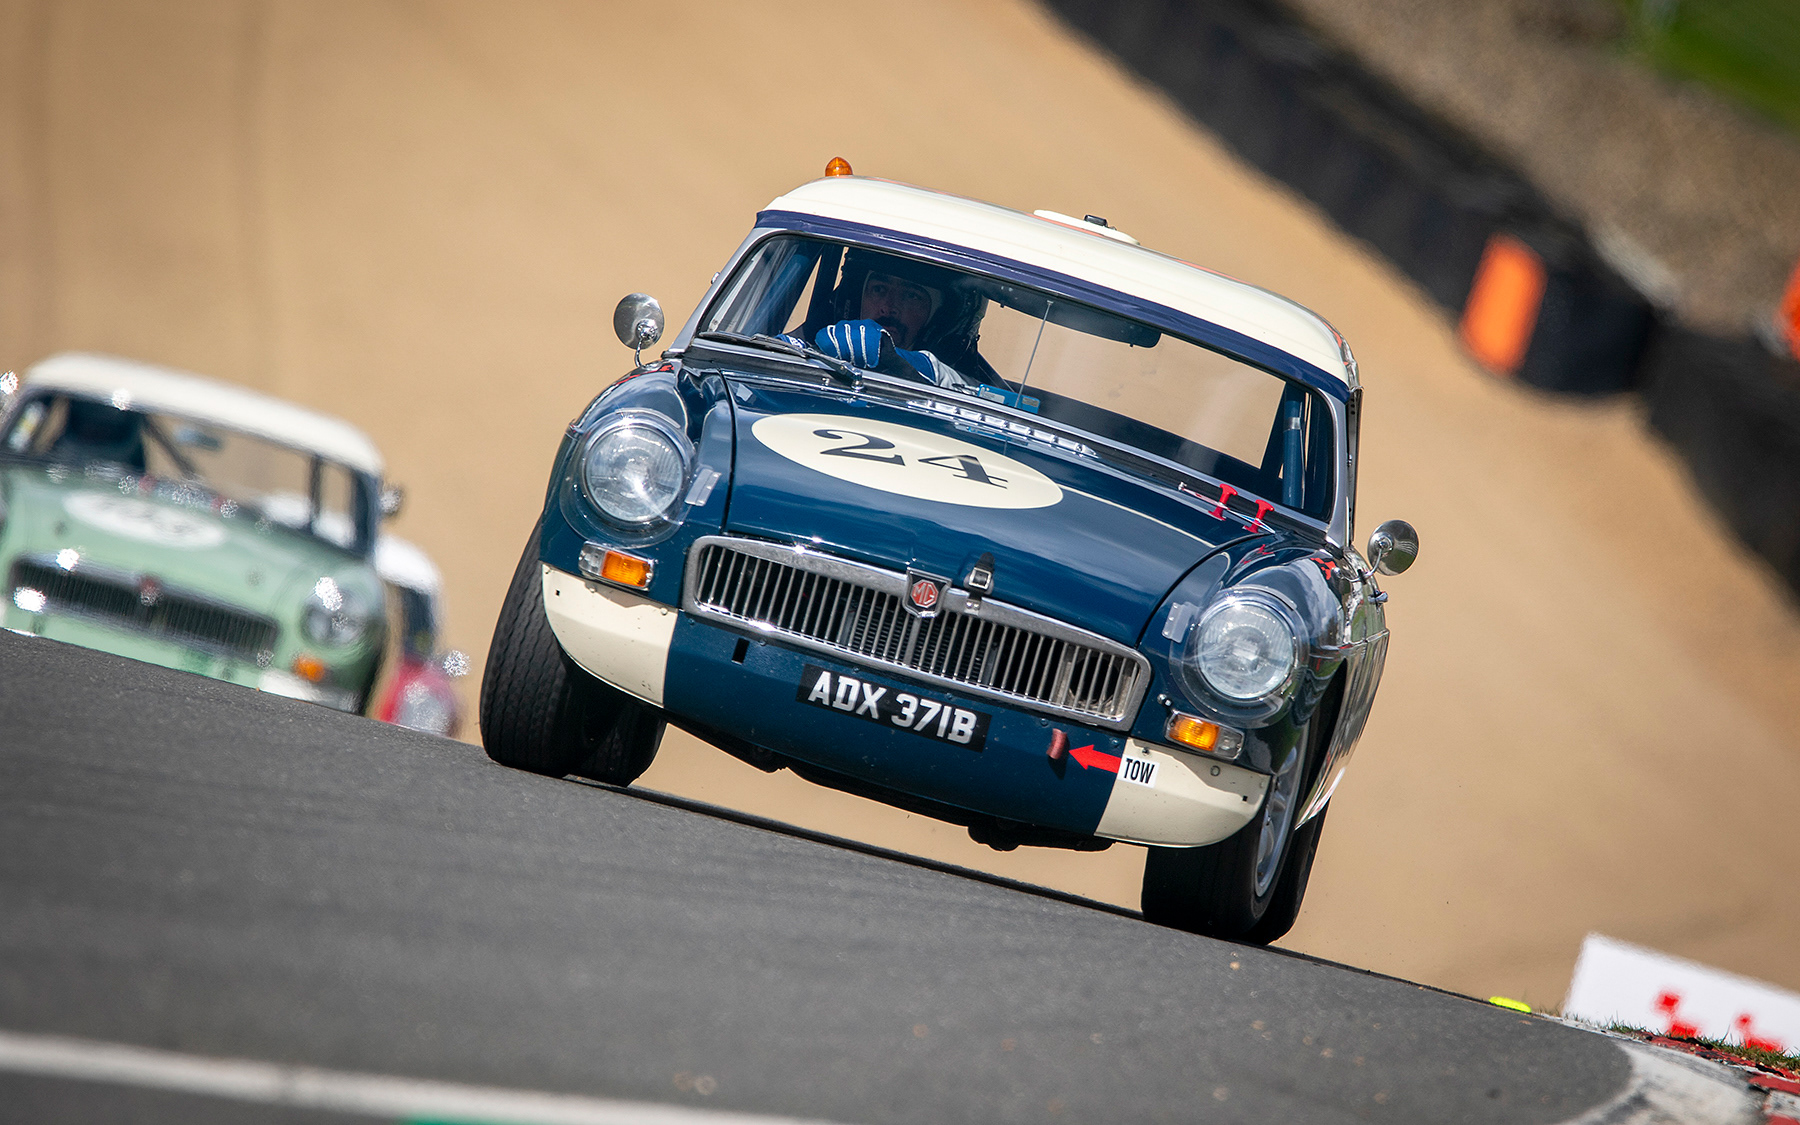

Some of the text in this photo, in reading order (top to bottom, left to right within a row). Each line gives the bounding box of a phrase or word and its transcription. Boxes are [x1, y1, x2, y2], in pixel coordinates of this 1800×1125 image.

[813, 429, 1008, 489] 24
[912, 581, 937, 606] MG
[807, 671, 977, 744] ADX 371B
[1124, 757, 1155, 784] TOW
